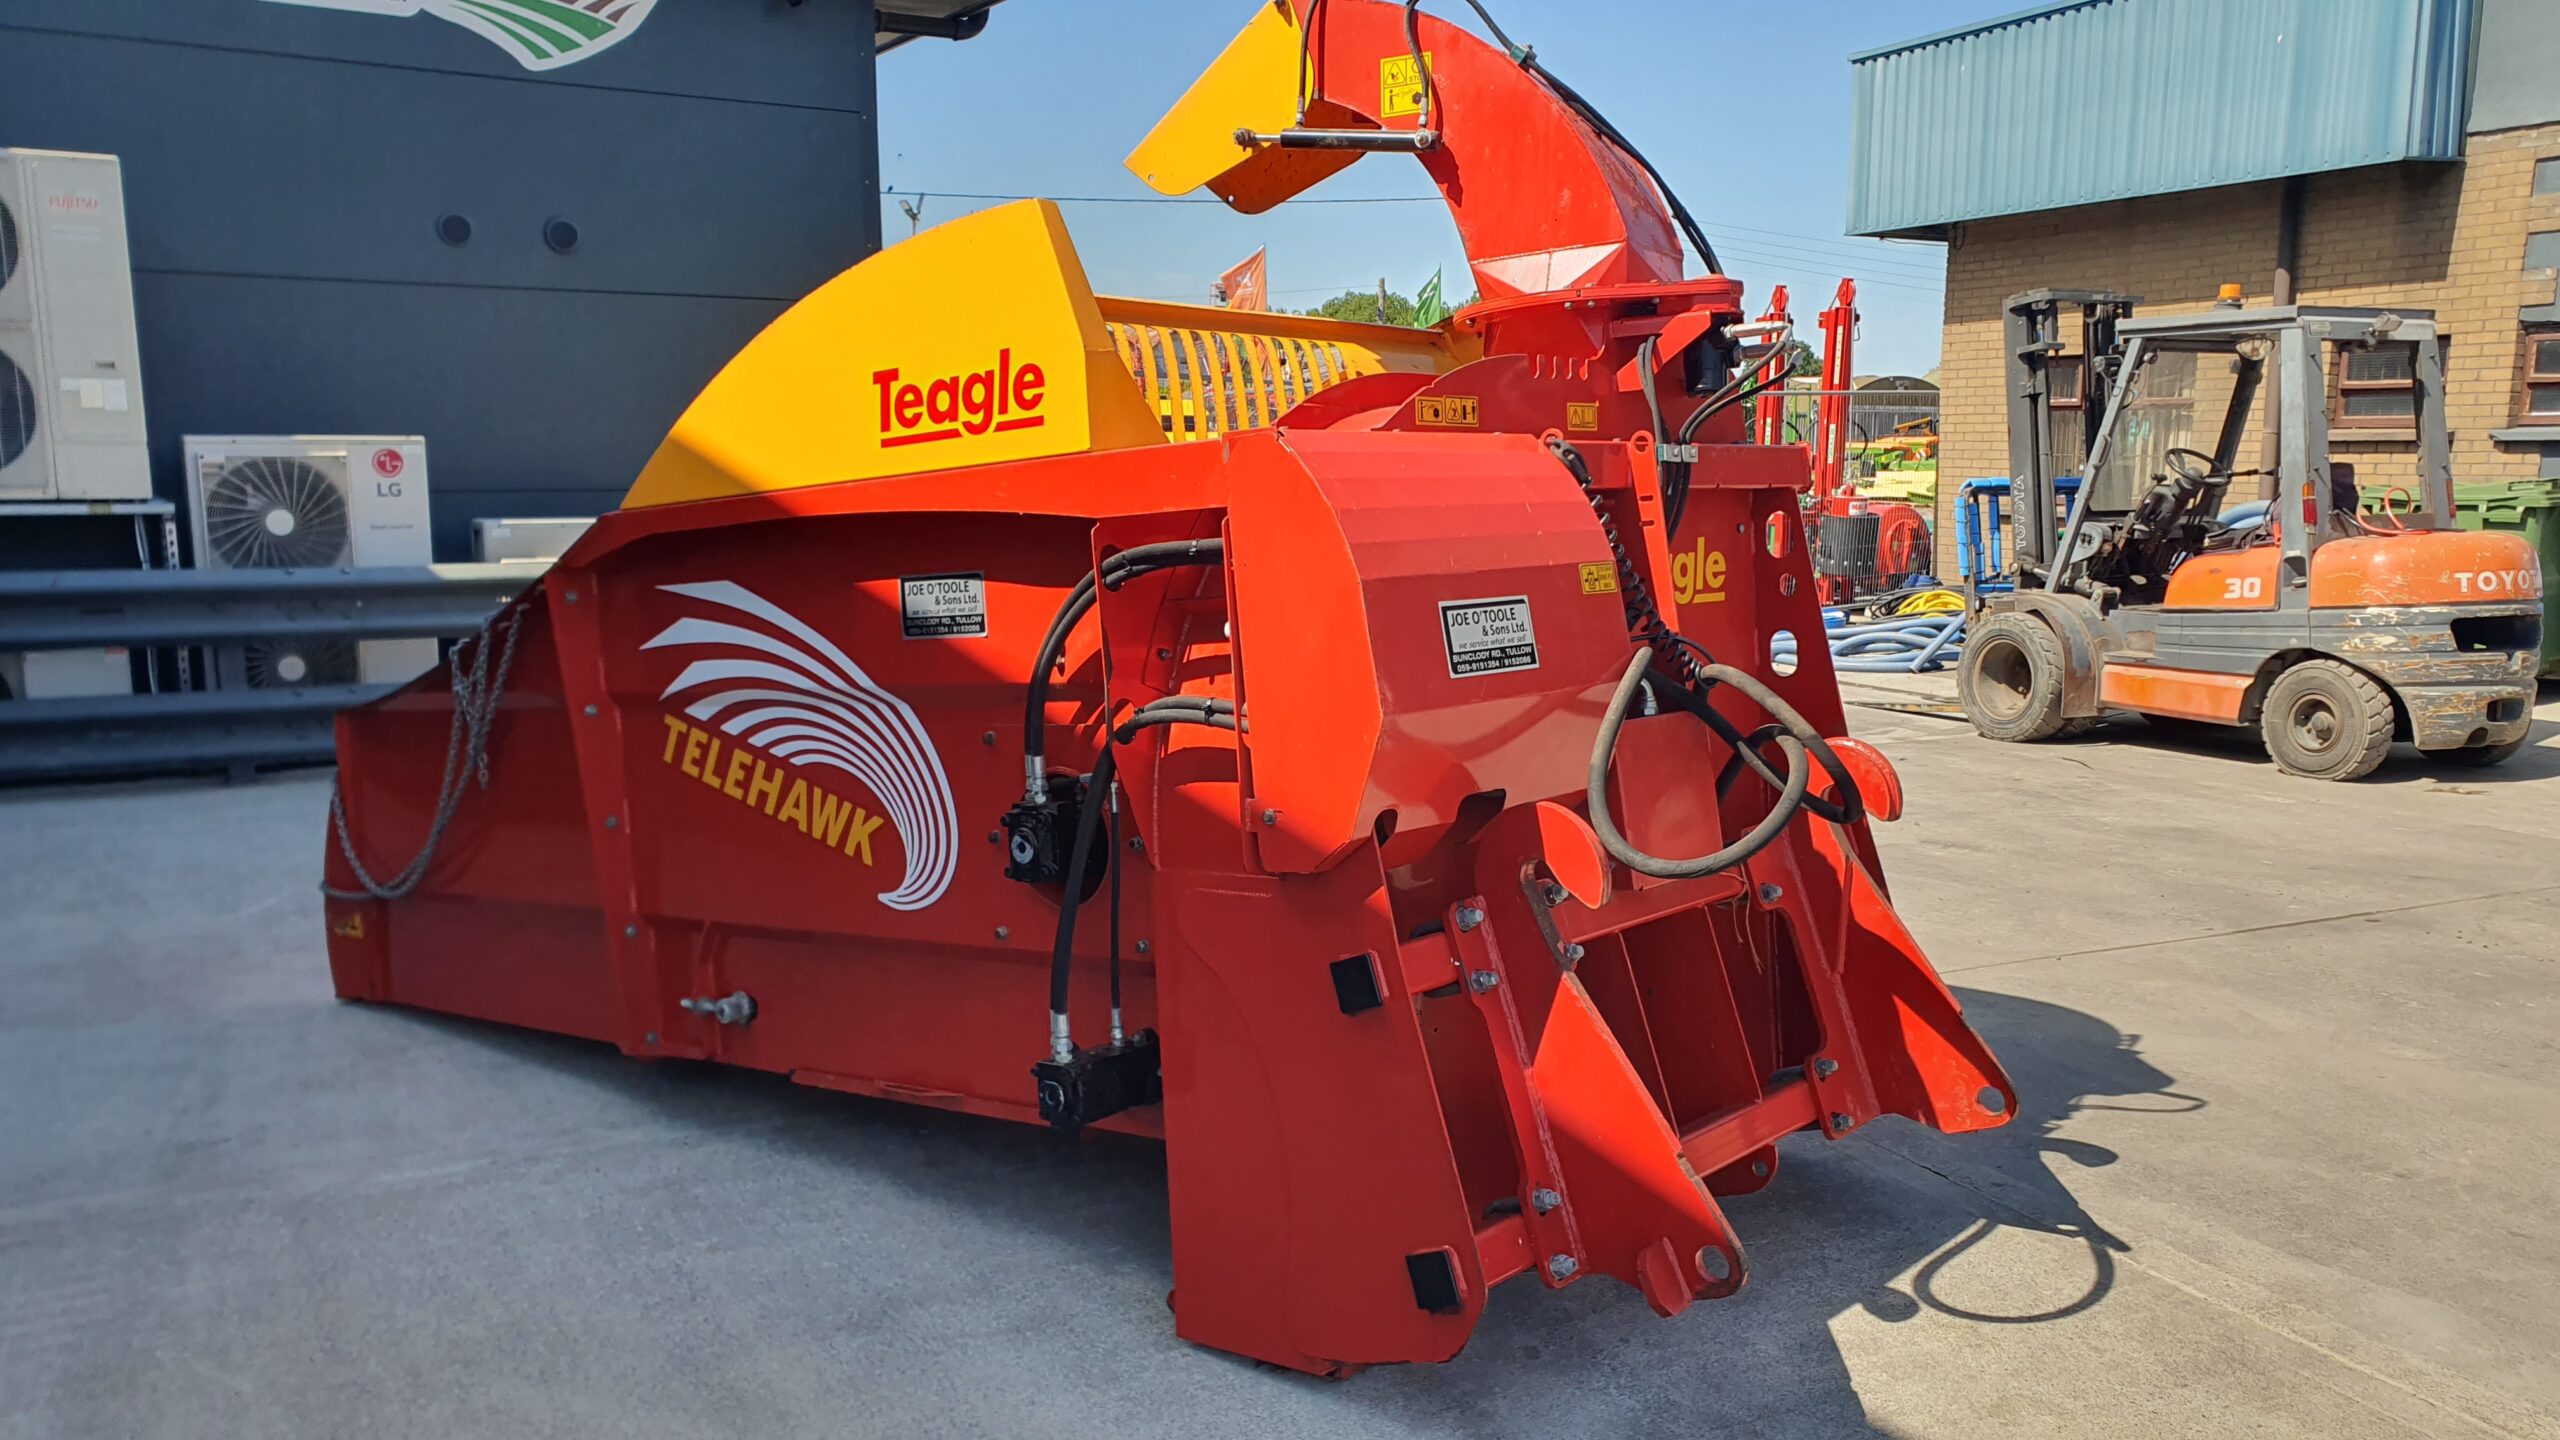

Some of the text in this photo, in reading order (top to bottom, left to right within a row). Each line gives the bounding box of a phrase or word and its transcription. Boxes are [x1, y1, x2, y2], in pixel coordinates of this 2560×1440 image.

[873, 348, 1045, 436] Teagle
[377, 482, 403, 497] LG
[2014, 475, 2026, 551] TOYOTA
[1669, 536, 1726, 605] gle
[907, 581, 969, 596] JOE O'TOOLE
[2223, 577, 2261, 598] 30
[2453, 569, 2539, 593] TOYOT
[934, 596, 940, 606] &
[942, 595, 962, 606] Sons
[956, 615, 982, 624] TULLOW
[1451, 607, 1517, 627] JOE O'TOOLE
[1482, 621, 1528, 637] & Sons Ltd.
[1469, 638, 1489, 649] service
[1490, 637, 1506, 646] what
[1516, 634, 1527, 643] sell
[1452, 650, 1490, 663] BUNCLODY
[1505, 646, 1532, 656] TULLOW
[662, 713, 884, 867] TELEHAWK
